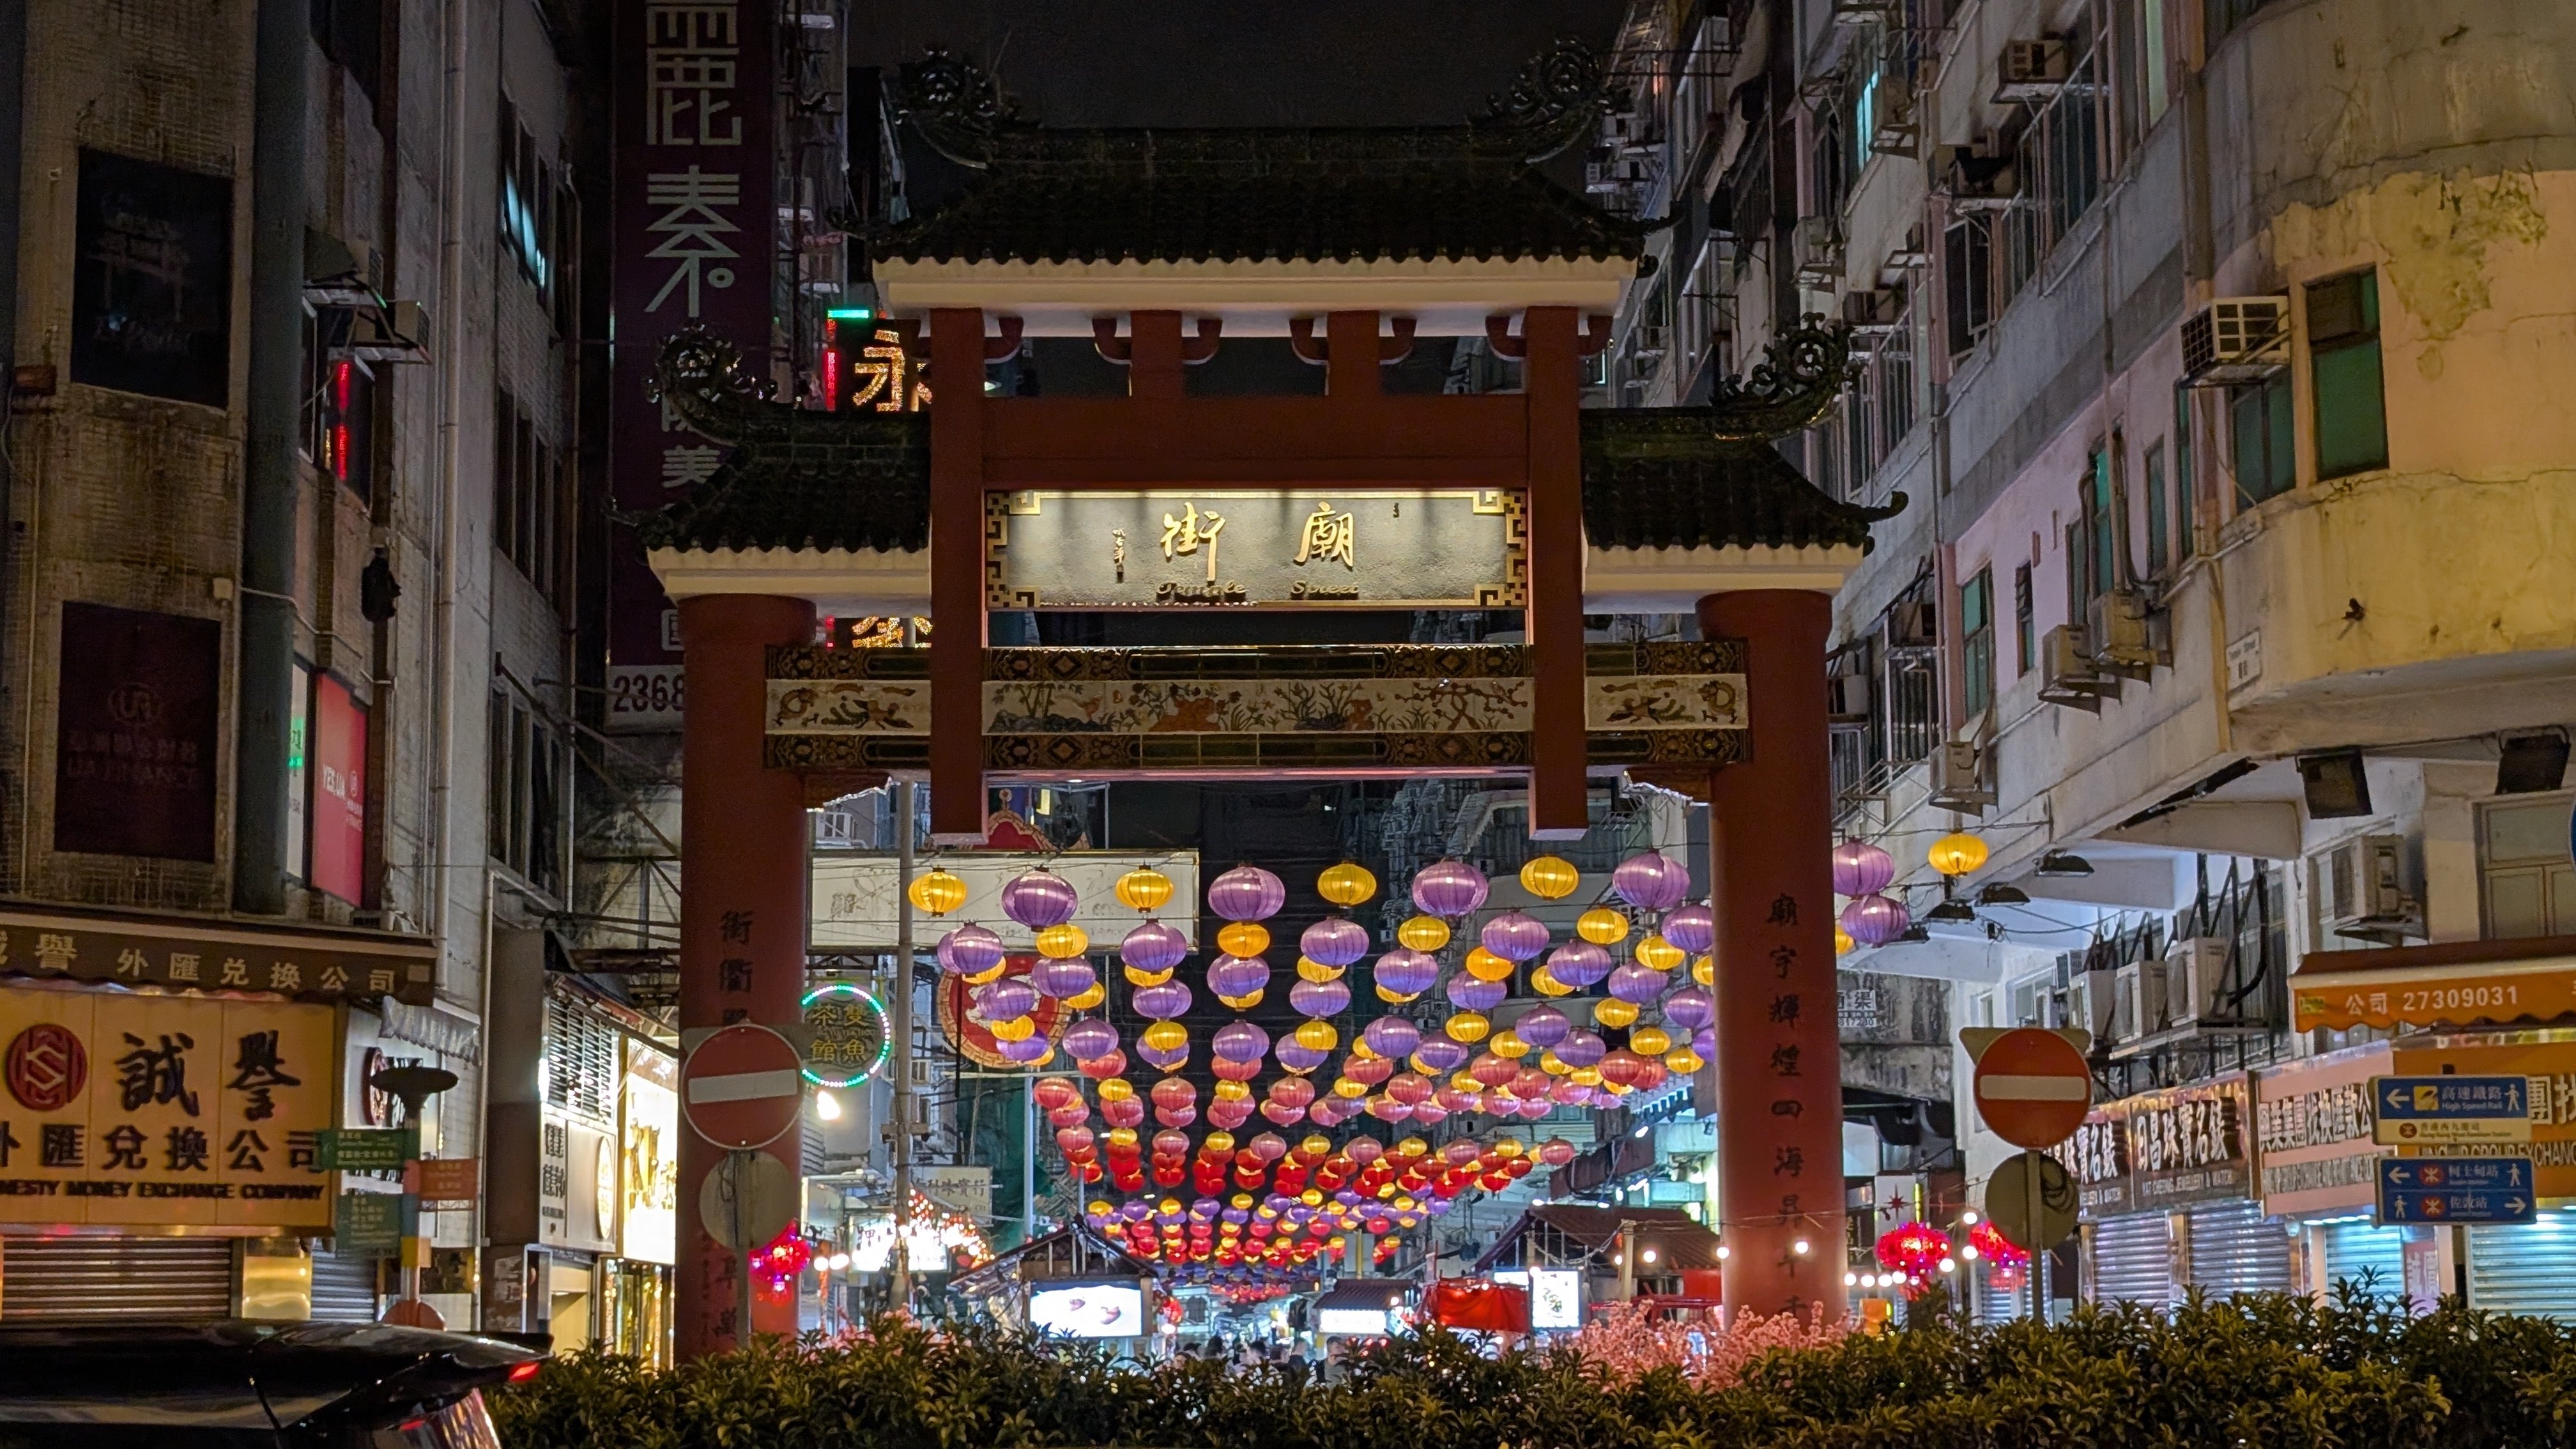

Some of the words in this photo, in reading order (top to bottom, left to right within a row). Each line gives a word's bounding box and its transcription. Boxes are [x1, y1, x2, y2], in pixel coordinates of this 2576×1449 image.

[1156, 579, 1248, 599] Temple
[1291, 579, 1360, 596] Street
[2345, 992, 2388, 1016] 公司
[2403, 985, 2518, 1011] 27309031
[2442, 1101, 2460, 1112] High
[2462, 1101, 2492, 1111] Speed
